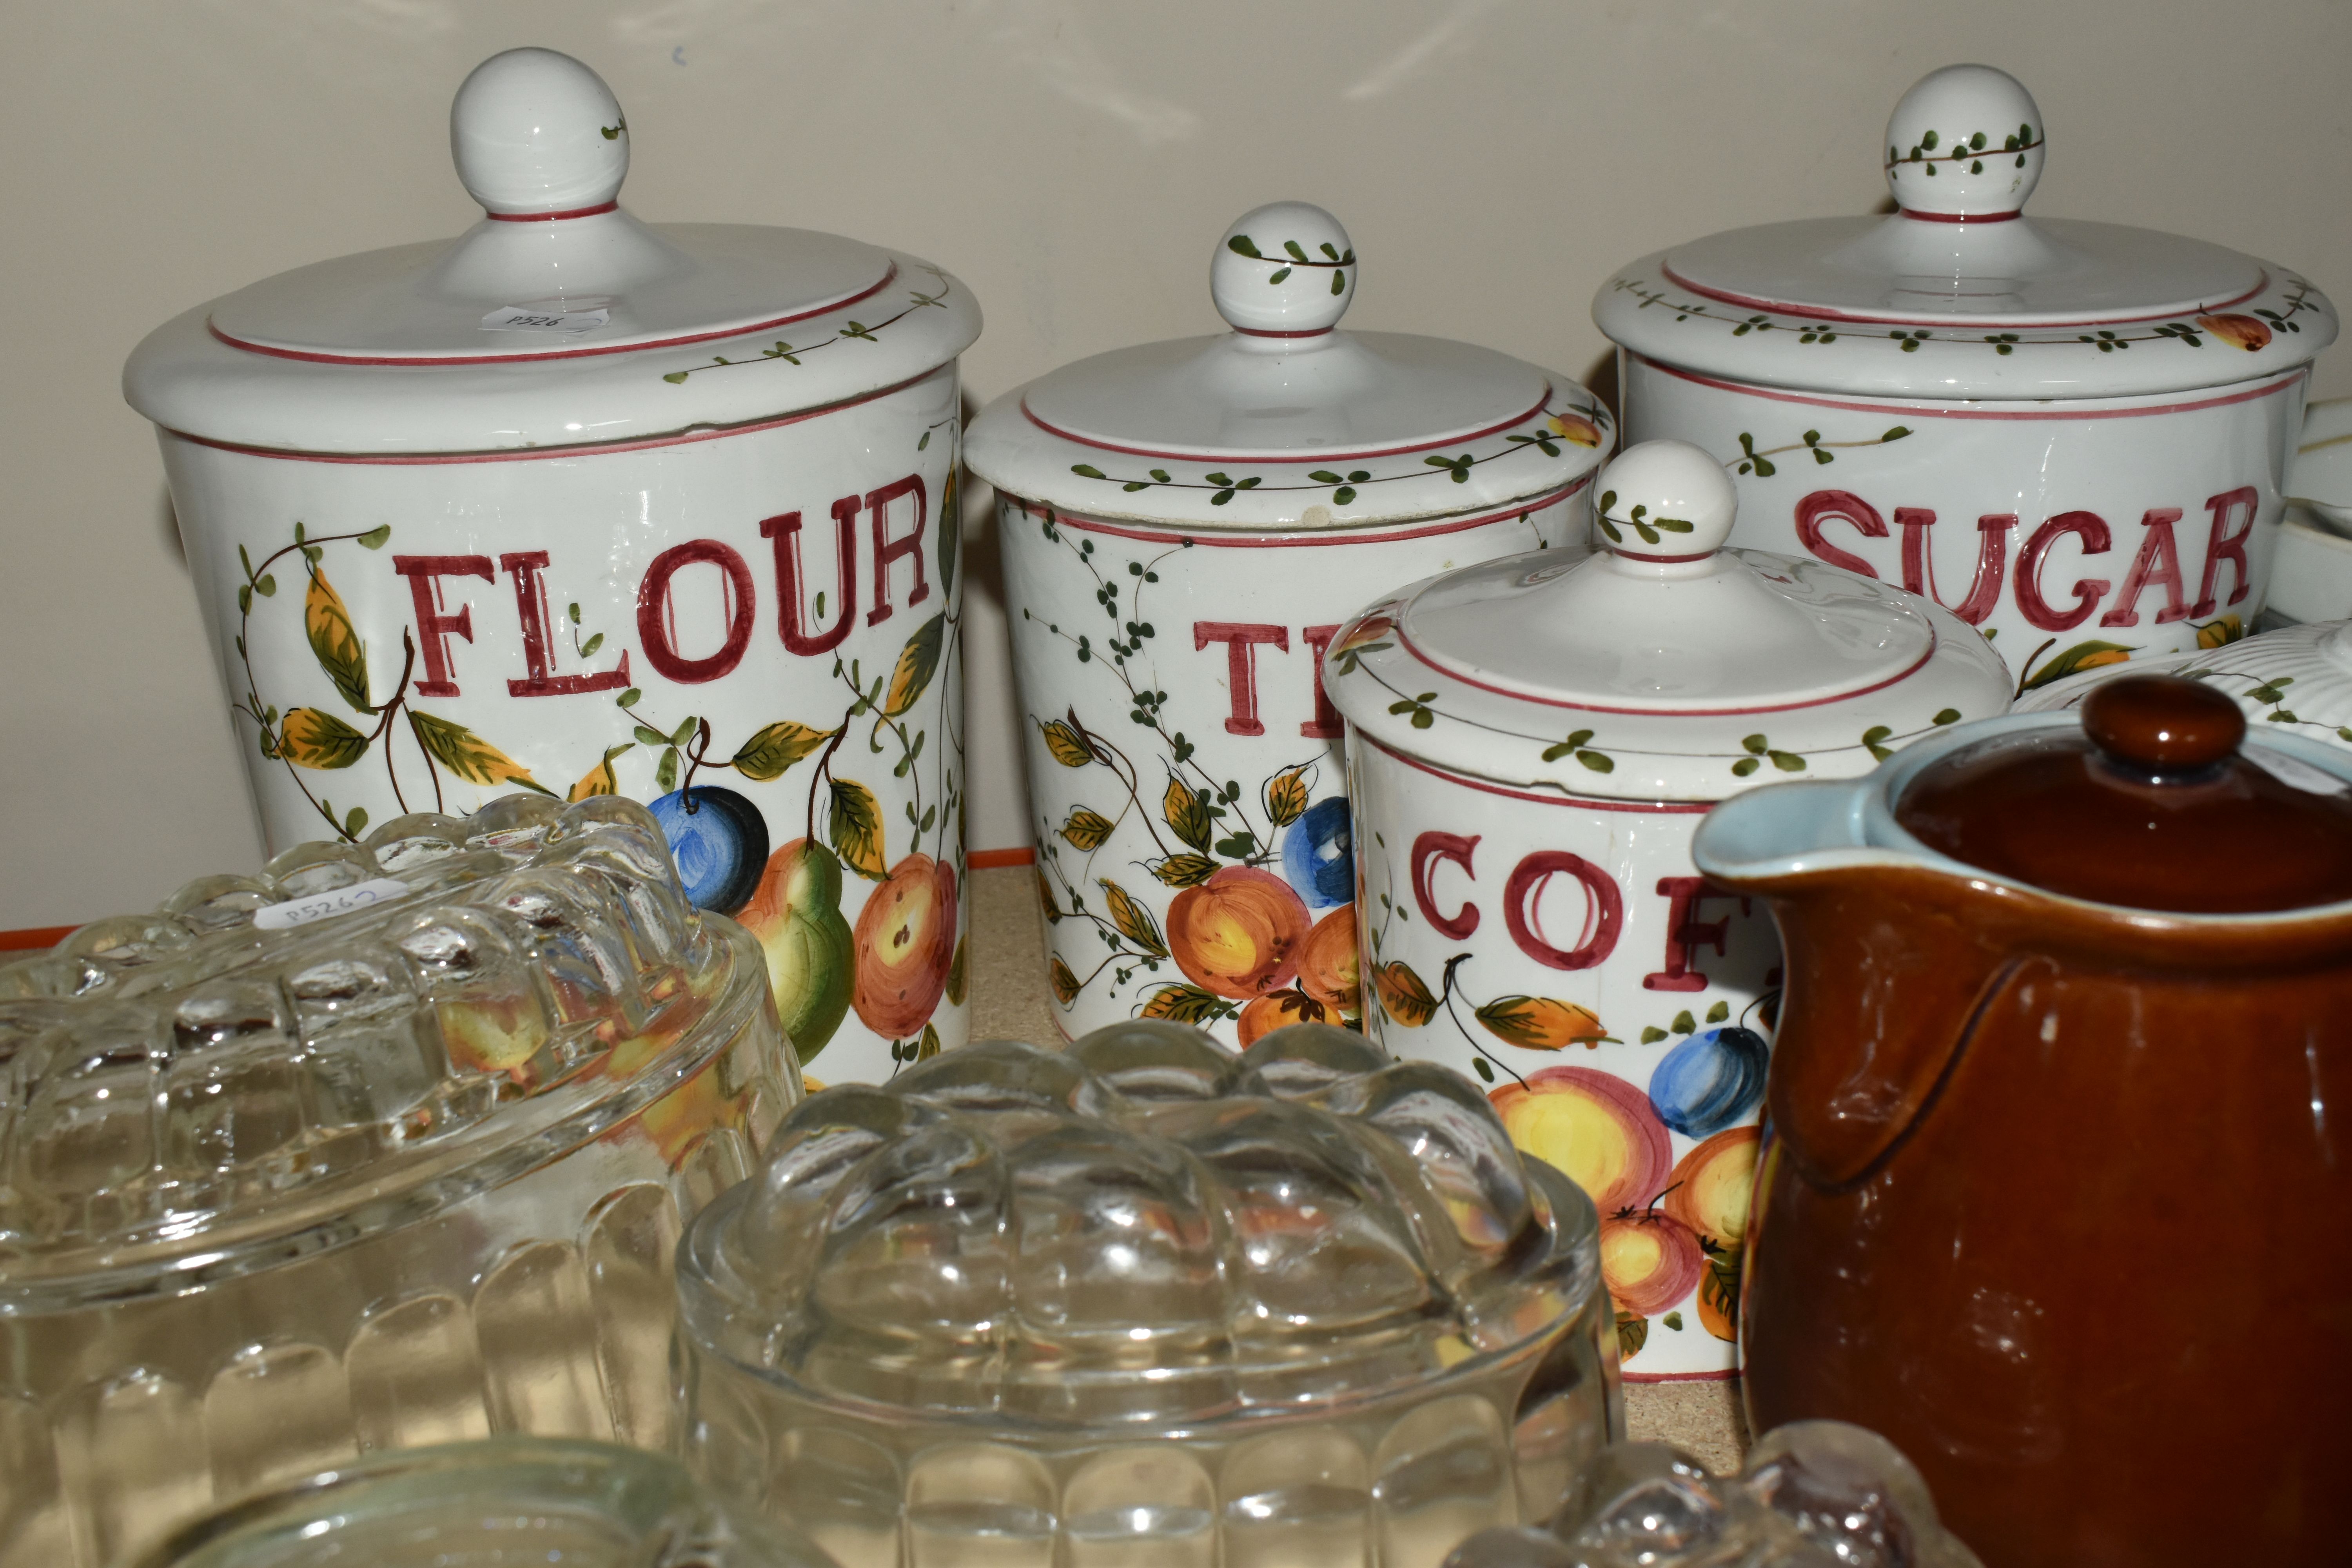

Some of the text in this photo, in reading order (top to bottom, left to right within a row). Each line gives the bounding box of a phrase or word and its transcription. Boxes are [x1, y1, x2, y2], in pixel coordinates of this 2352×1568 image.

[506, 316, 565, 327] P526
[392, 474, 928, 697] FLOUR
[1794, 485, 2258, 632] SUGAR
[1411, 831, 1783, 992] COF
